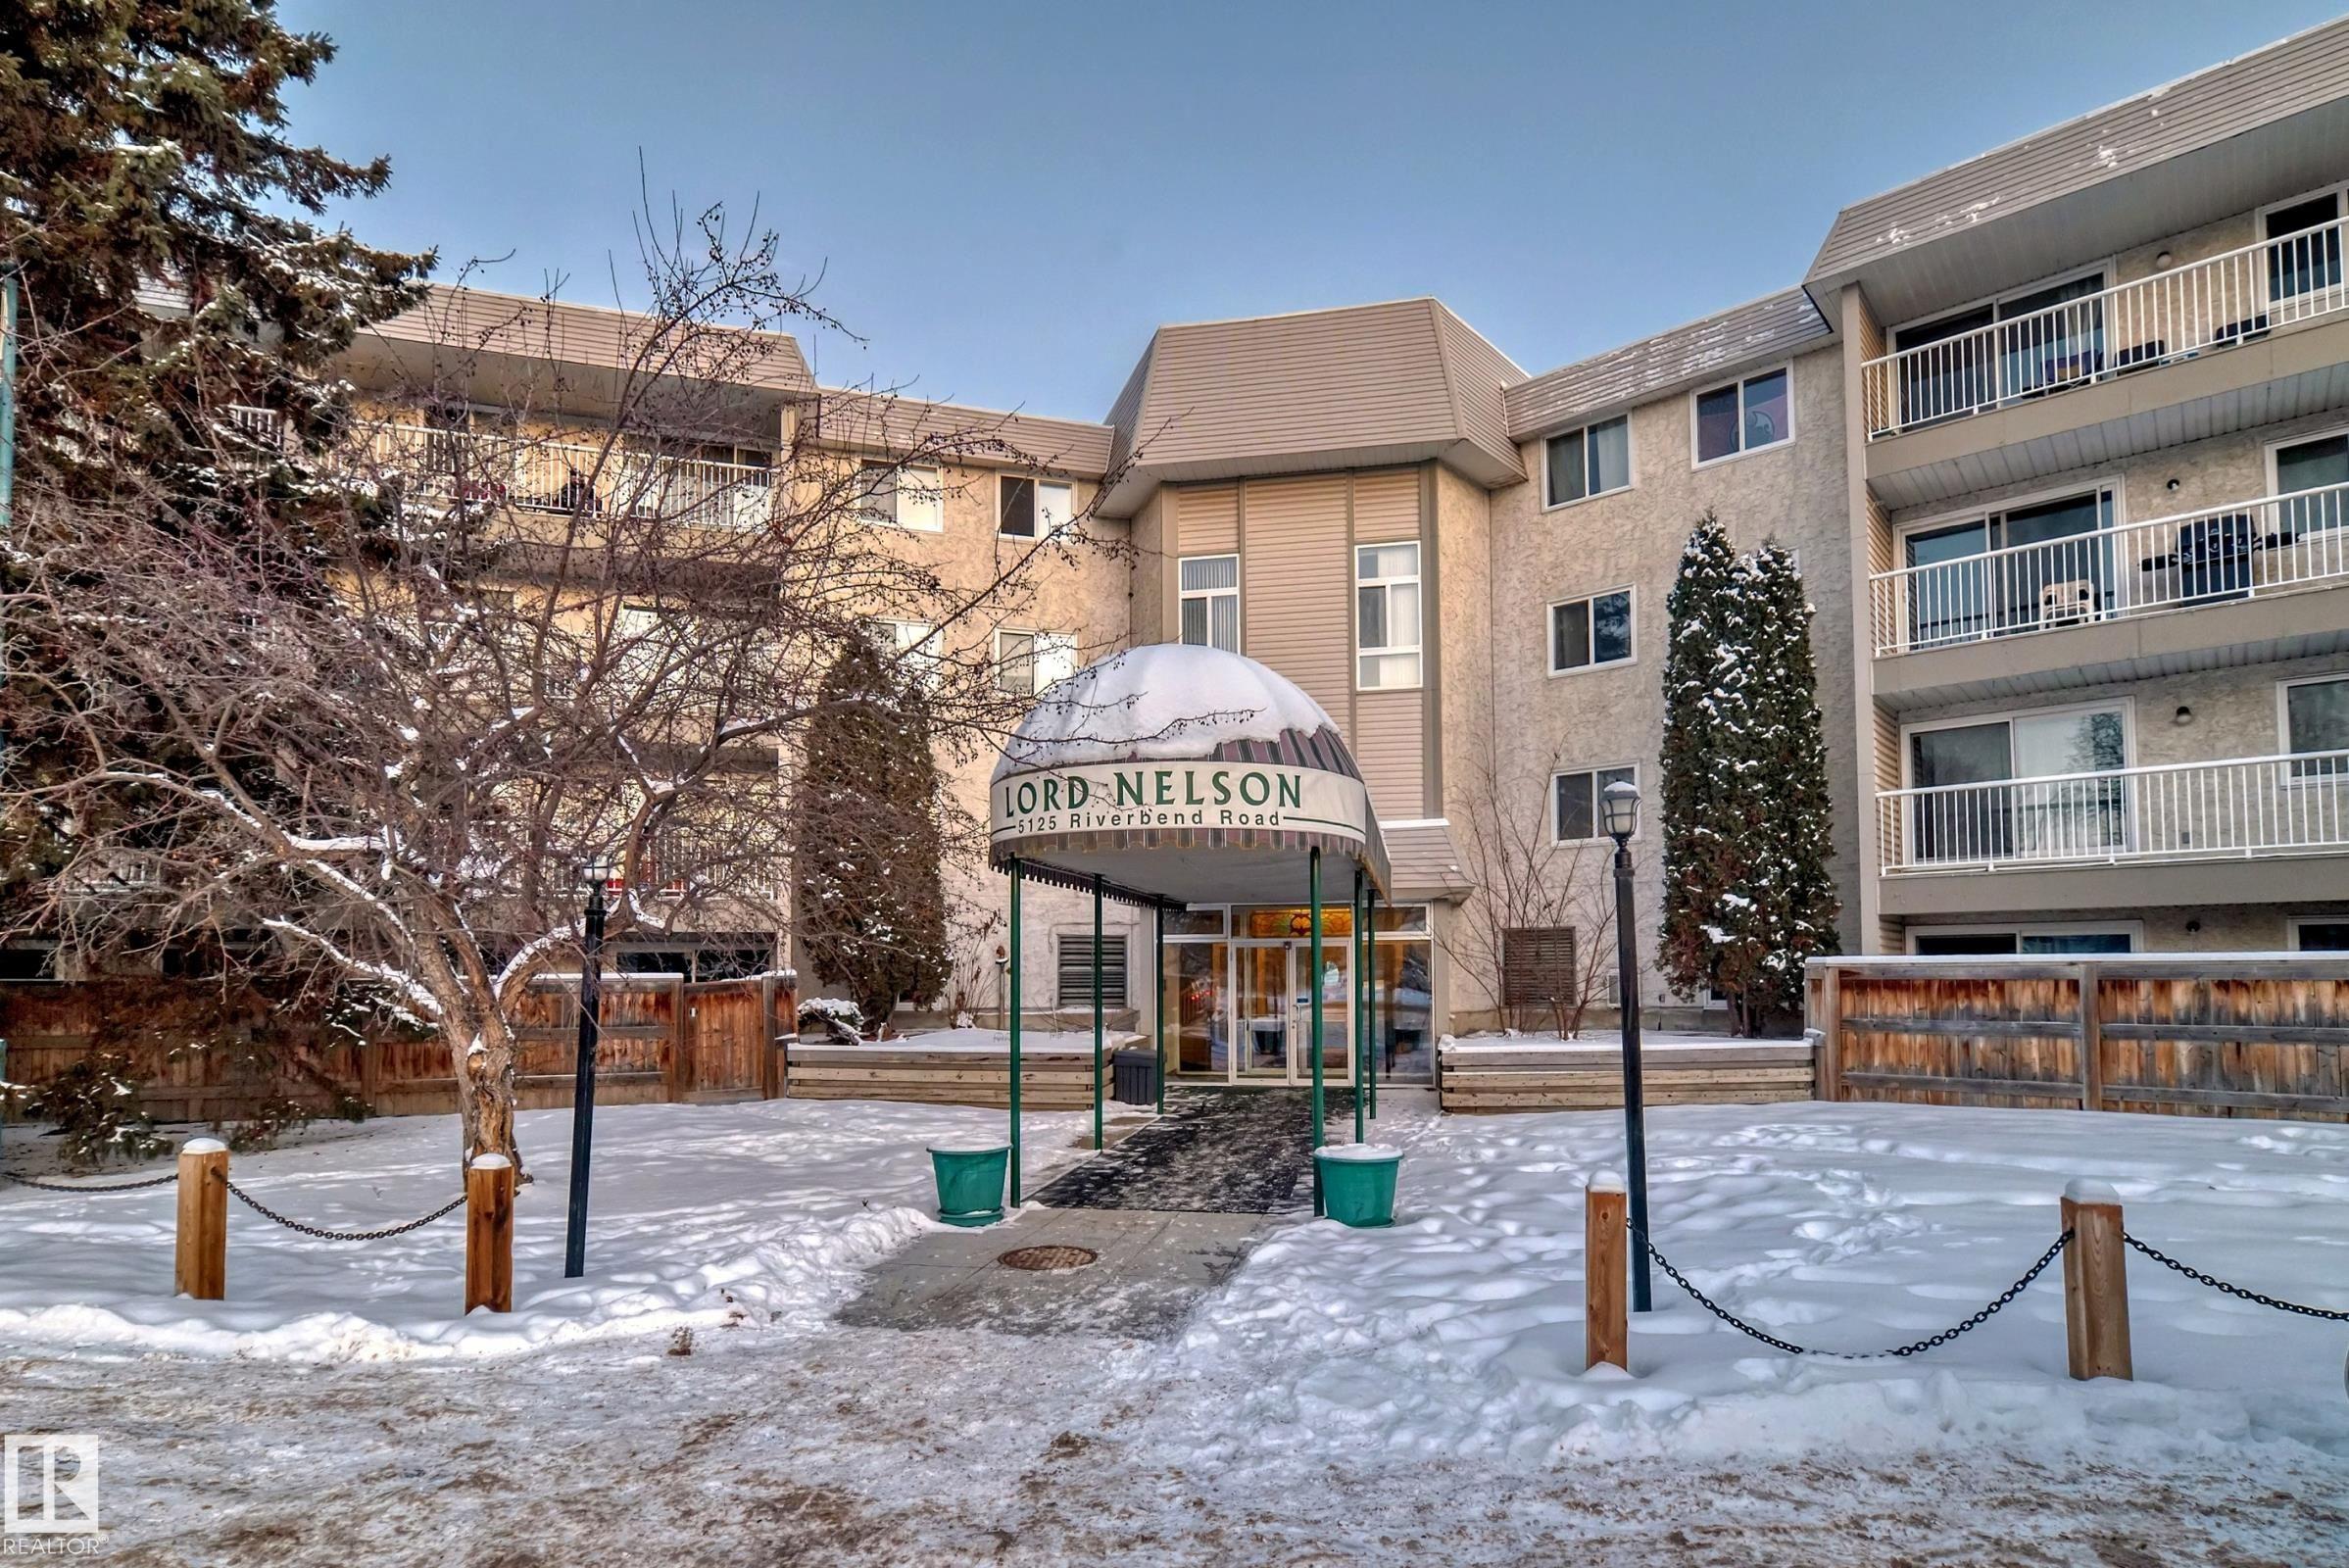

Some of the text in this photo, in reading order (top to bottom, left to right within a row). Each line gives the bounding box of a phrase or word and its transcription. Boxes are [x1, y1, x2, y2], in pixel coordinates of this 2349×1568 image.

[1005, 770, 1301, 818] LORD NELSON
[1018, 809, 1280, 834] 5125 Riverbend Road
